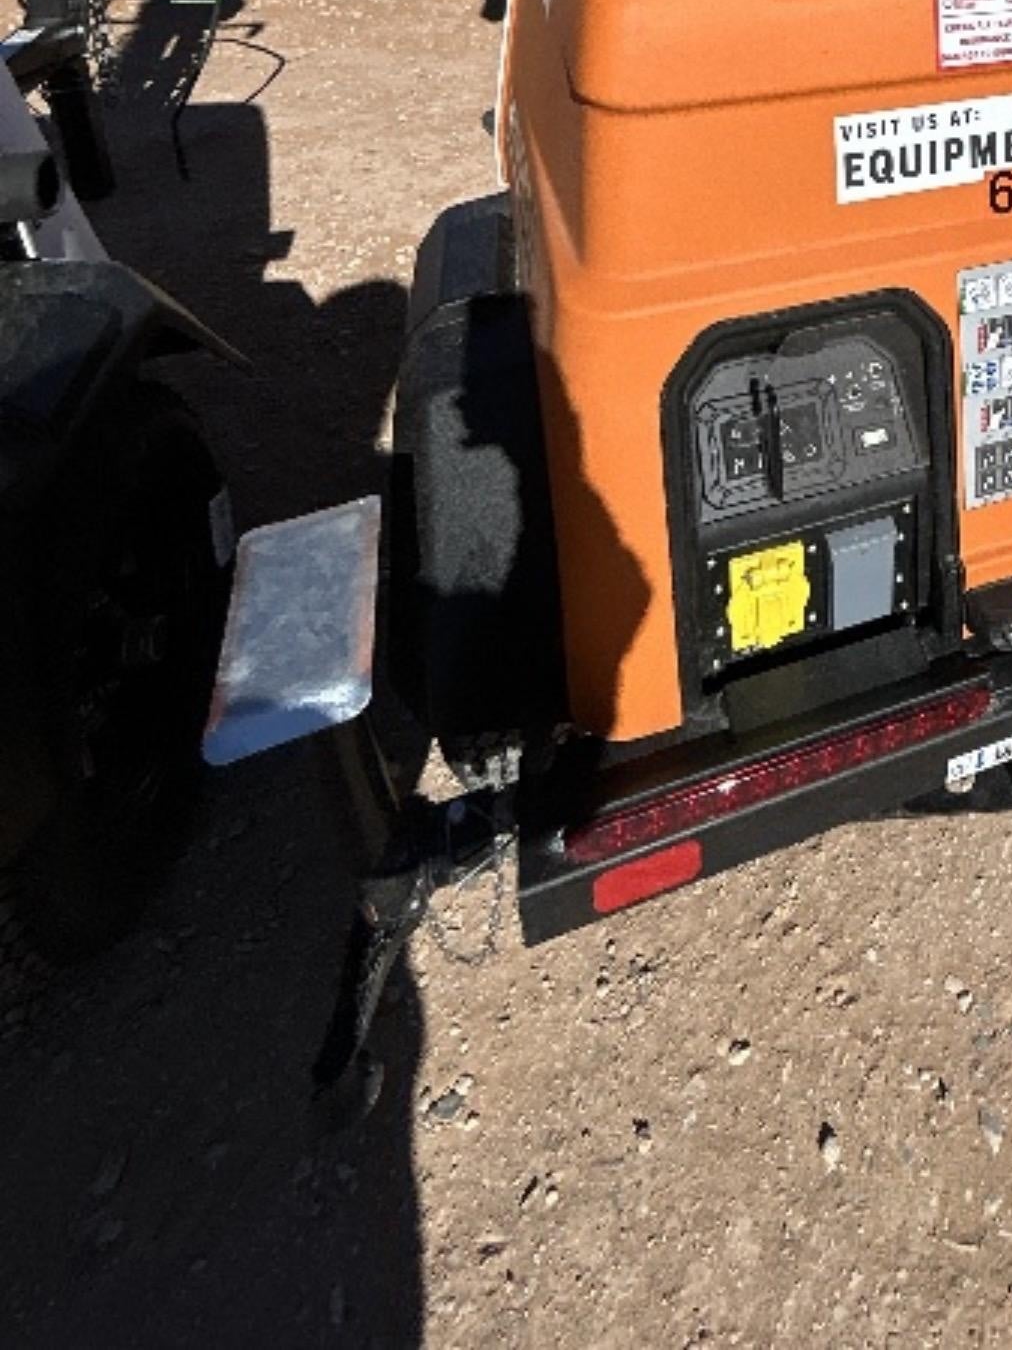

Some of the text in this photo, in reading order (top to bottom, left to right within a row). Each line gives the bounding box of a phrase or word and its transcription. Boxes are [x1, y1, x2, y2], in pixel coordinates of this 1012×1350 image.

[840, 107, 982, 143] VISIT US AT:
